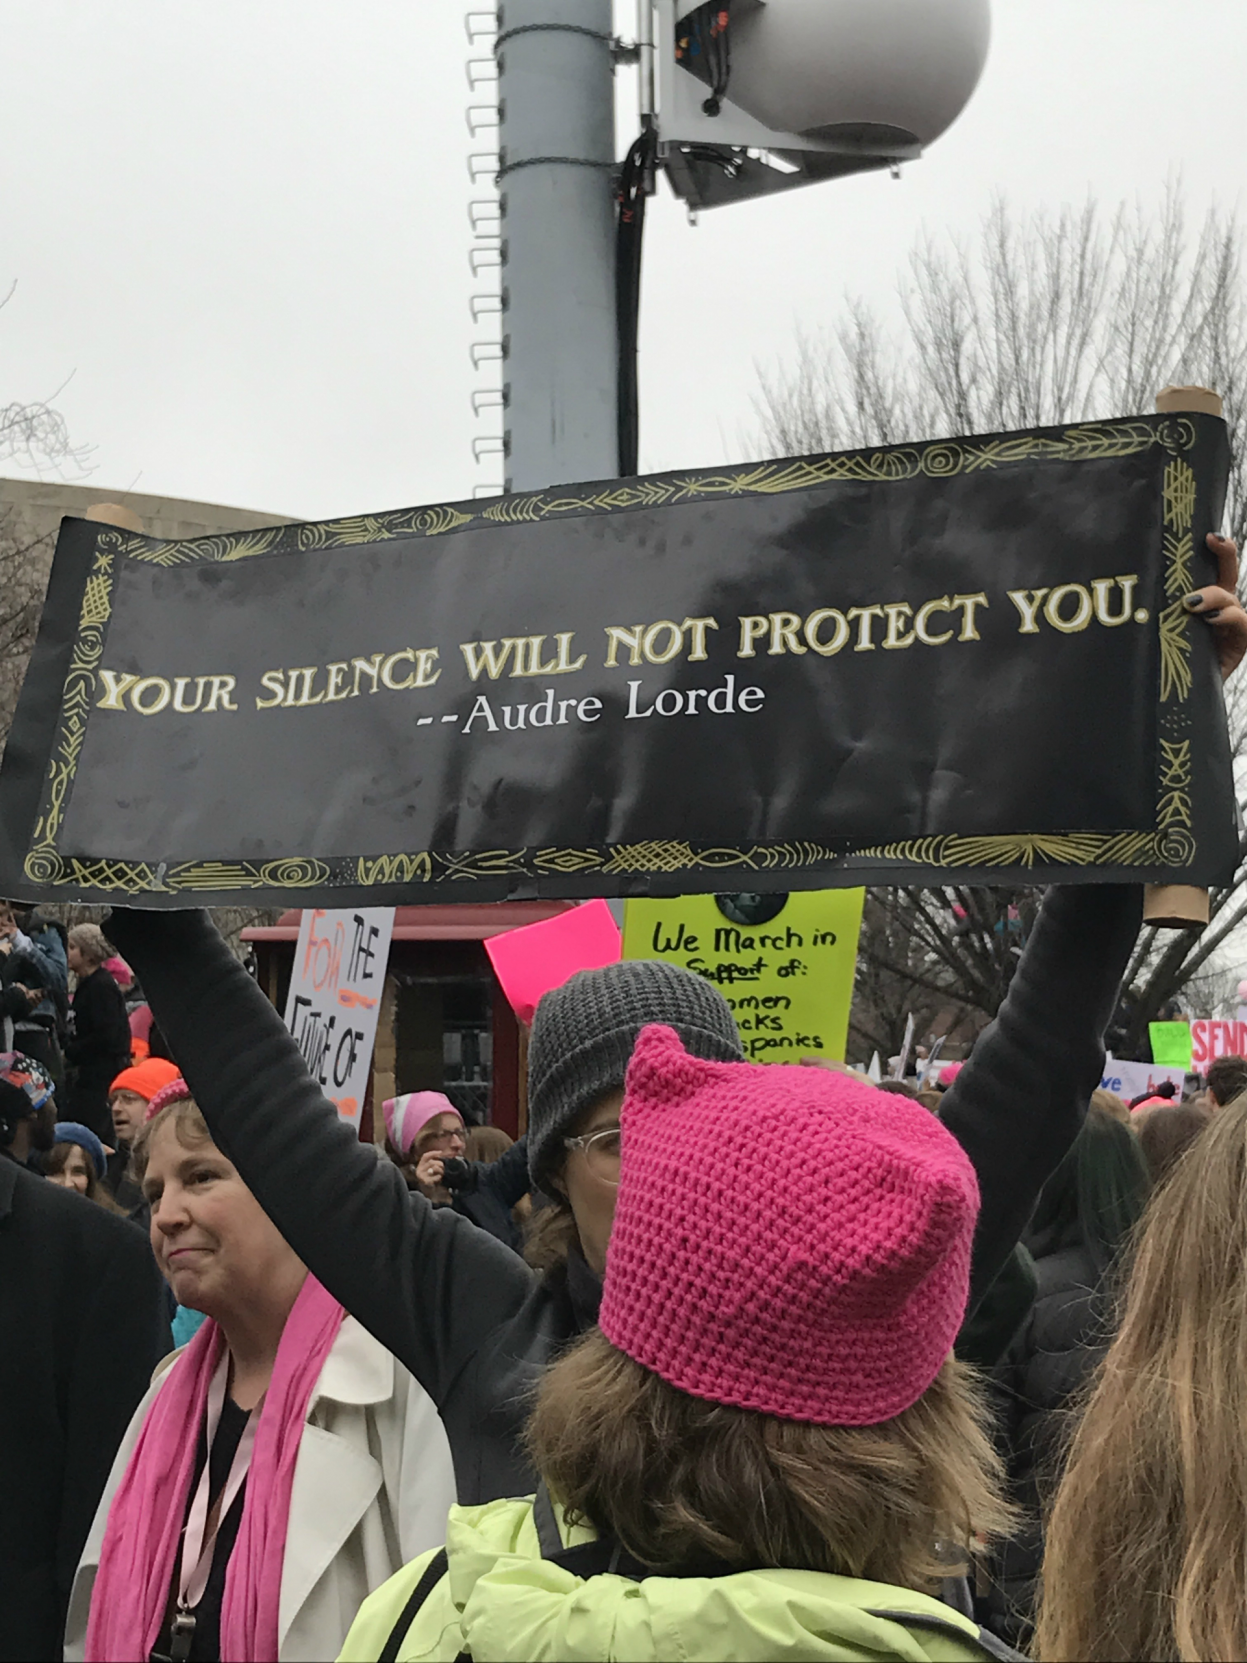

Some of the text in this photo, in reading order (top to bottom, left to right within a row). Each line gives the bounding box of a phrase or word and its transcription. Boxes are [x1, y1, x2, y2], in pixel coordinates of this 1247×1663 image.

[96, 574, 1150, 716] YOUR SILENCE WILL NOT PROTECT YOU.
[624, 673, 766, 719] Lorde
[346, 913, 380, 984] THE
[652, 921, 837, 954] We March in
[685, 956, 808, 985] Support of:
[726, 995, 792, 1011] omen
[333, 1027, 365, 1088] OF
[740, 1032, 824, 1059] spanics
[1100, 1076, 1122, 1092] ve
